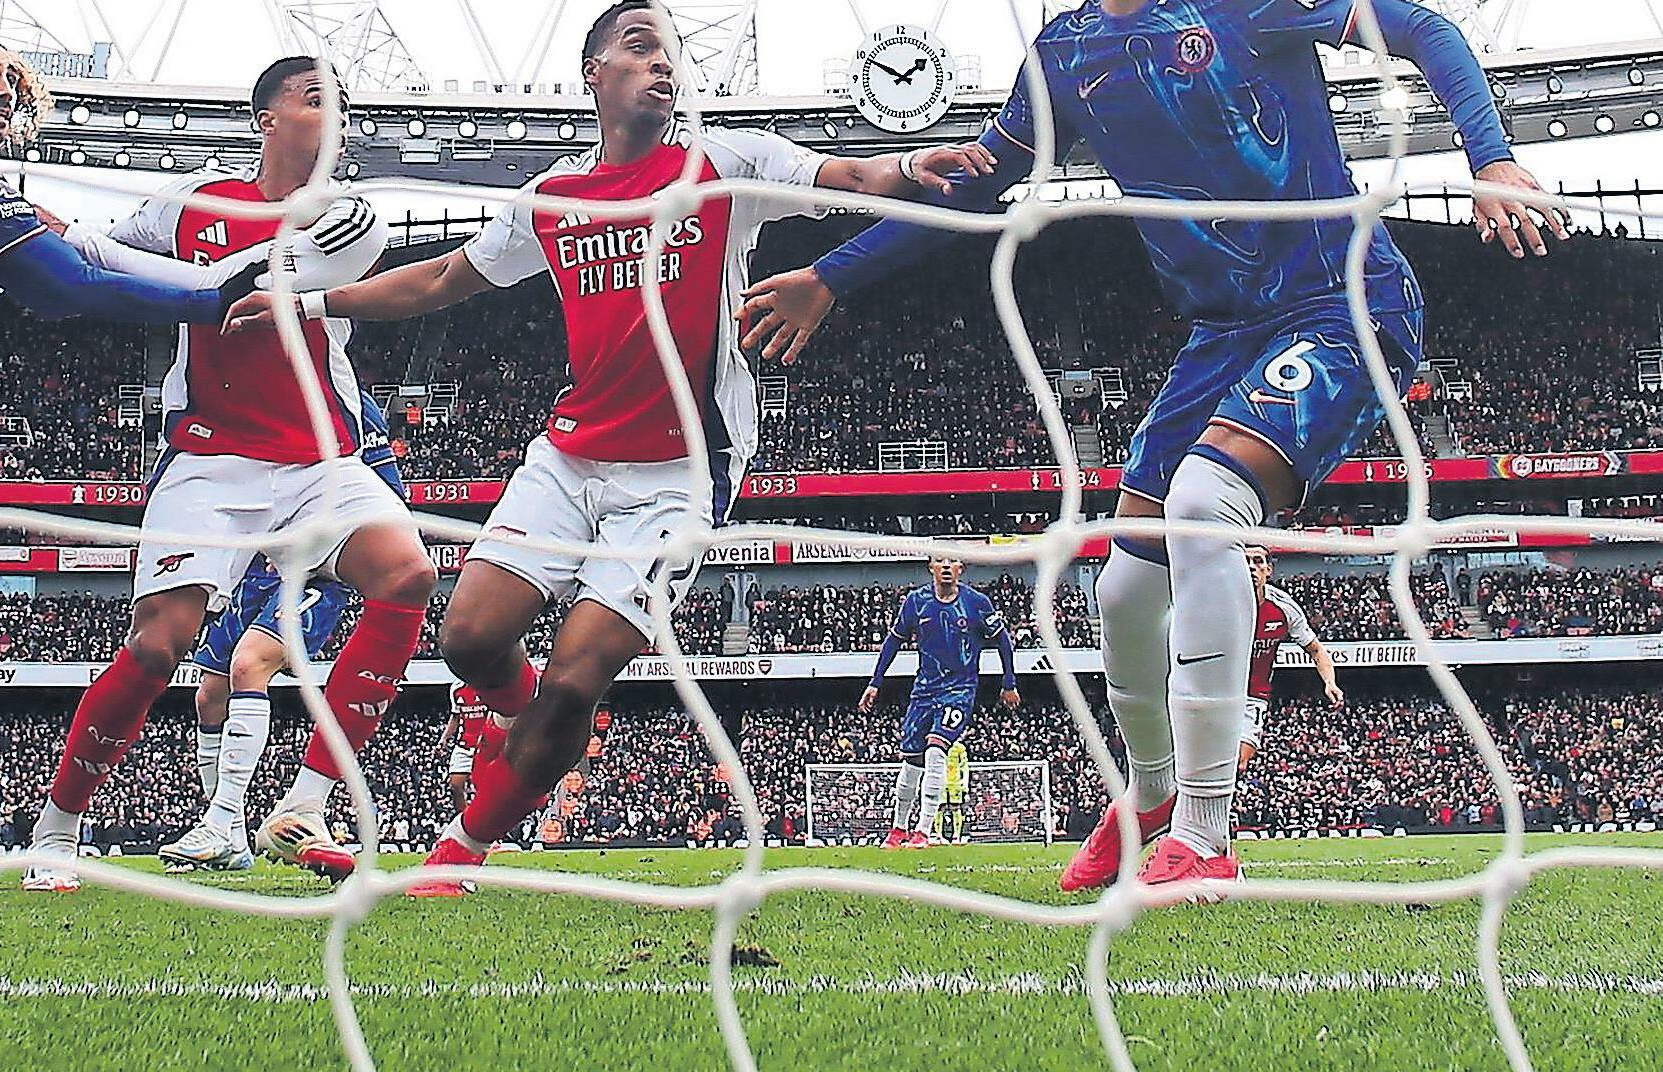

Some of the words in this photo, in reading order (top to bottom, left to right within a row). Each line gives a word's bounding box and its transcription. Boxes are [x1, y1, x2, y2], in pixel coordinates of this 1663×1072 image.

[556, 215, 704, 269] Emiraes
[579, 265, 606, 296] FLY
[612, 253, 681, 290] BETER
[1263, 339, 1315, 393] 6
[95, 486, 142, 502] 1930
[424, 484, 469, 500] 1931
[749, 479, 797, 495] 1933
[705, 542, 771, 563] ovenia
[796, 542, 852, 559] ARSENAL
[1355, 647, 1376, 663] FLY
[1377, 646, 1417, 662] BETTER
[627, 662, 644, 677] MY
[647, 661, 698, 677] ARSAL
[701, 660, 756, 675] REWARDS
[941, 706, 963, 728] 19
